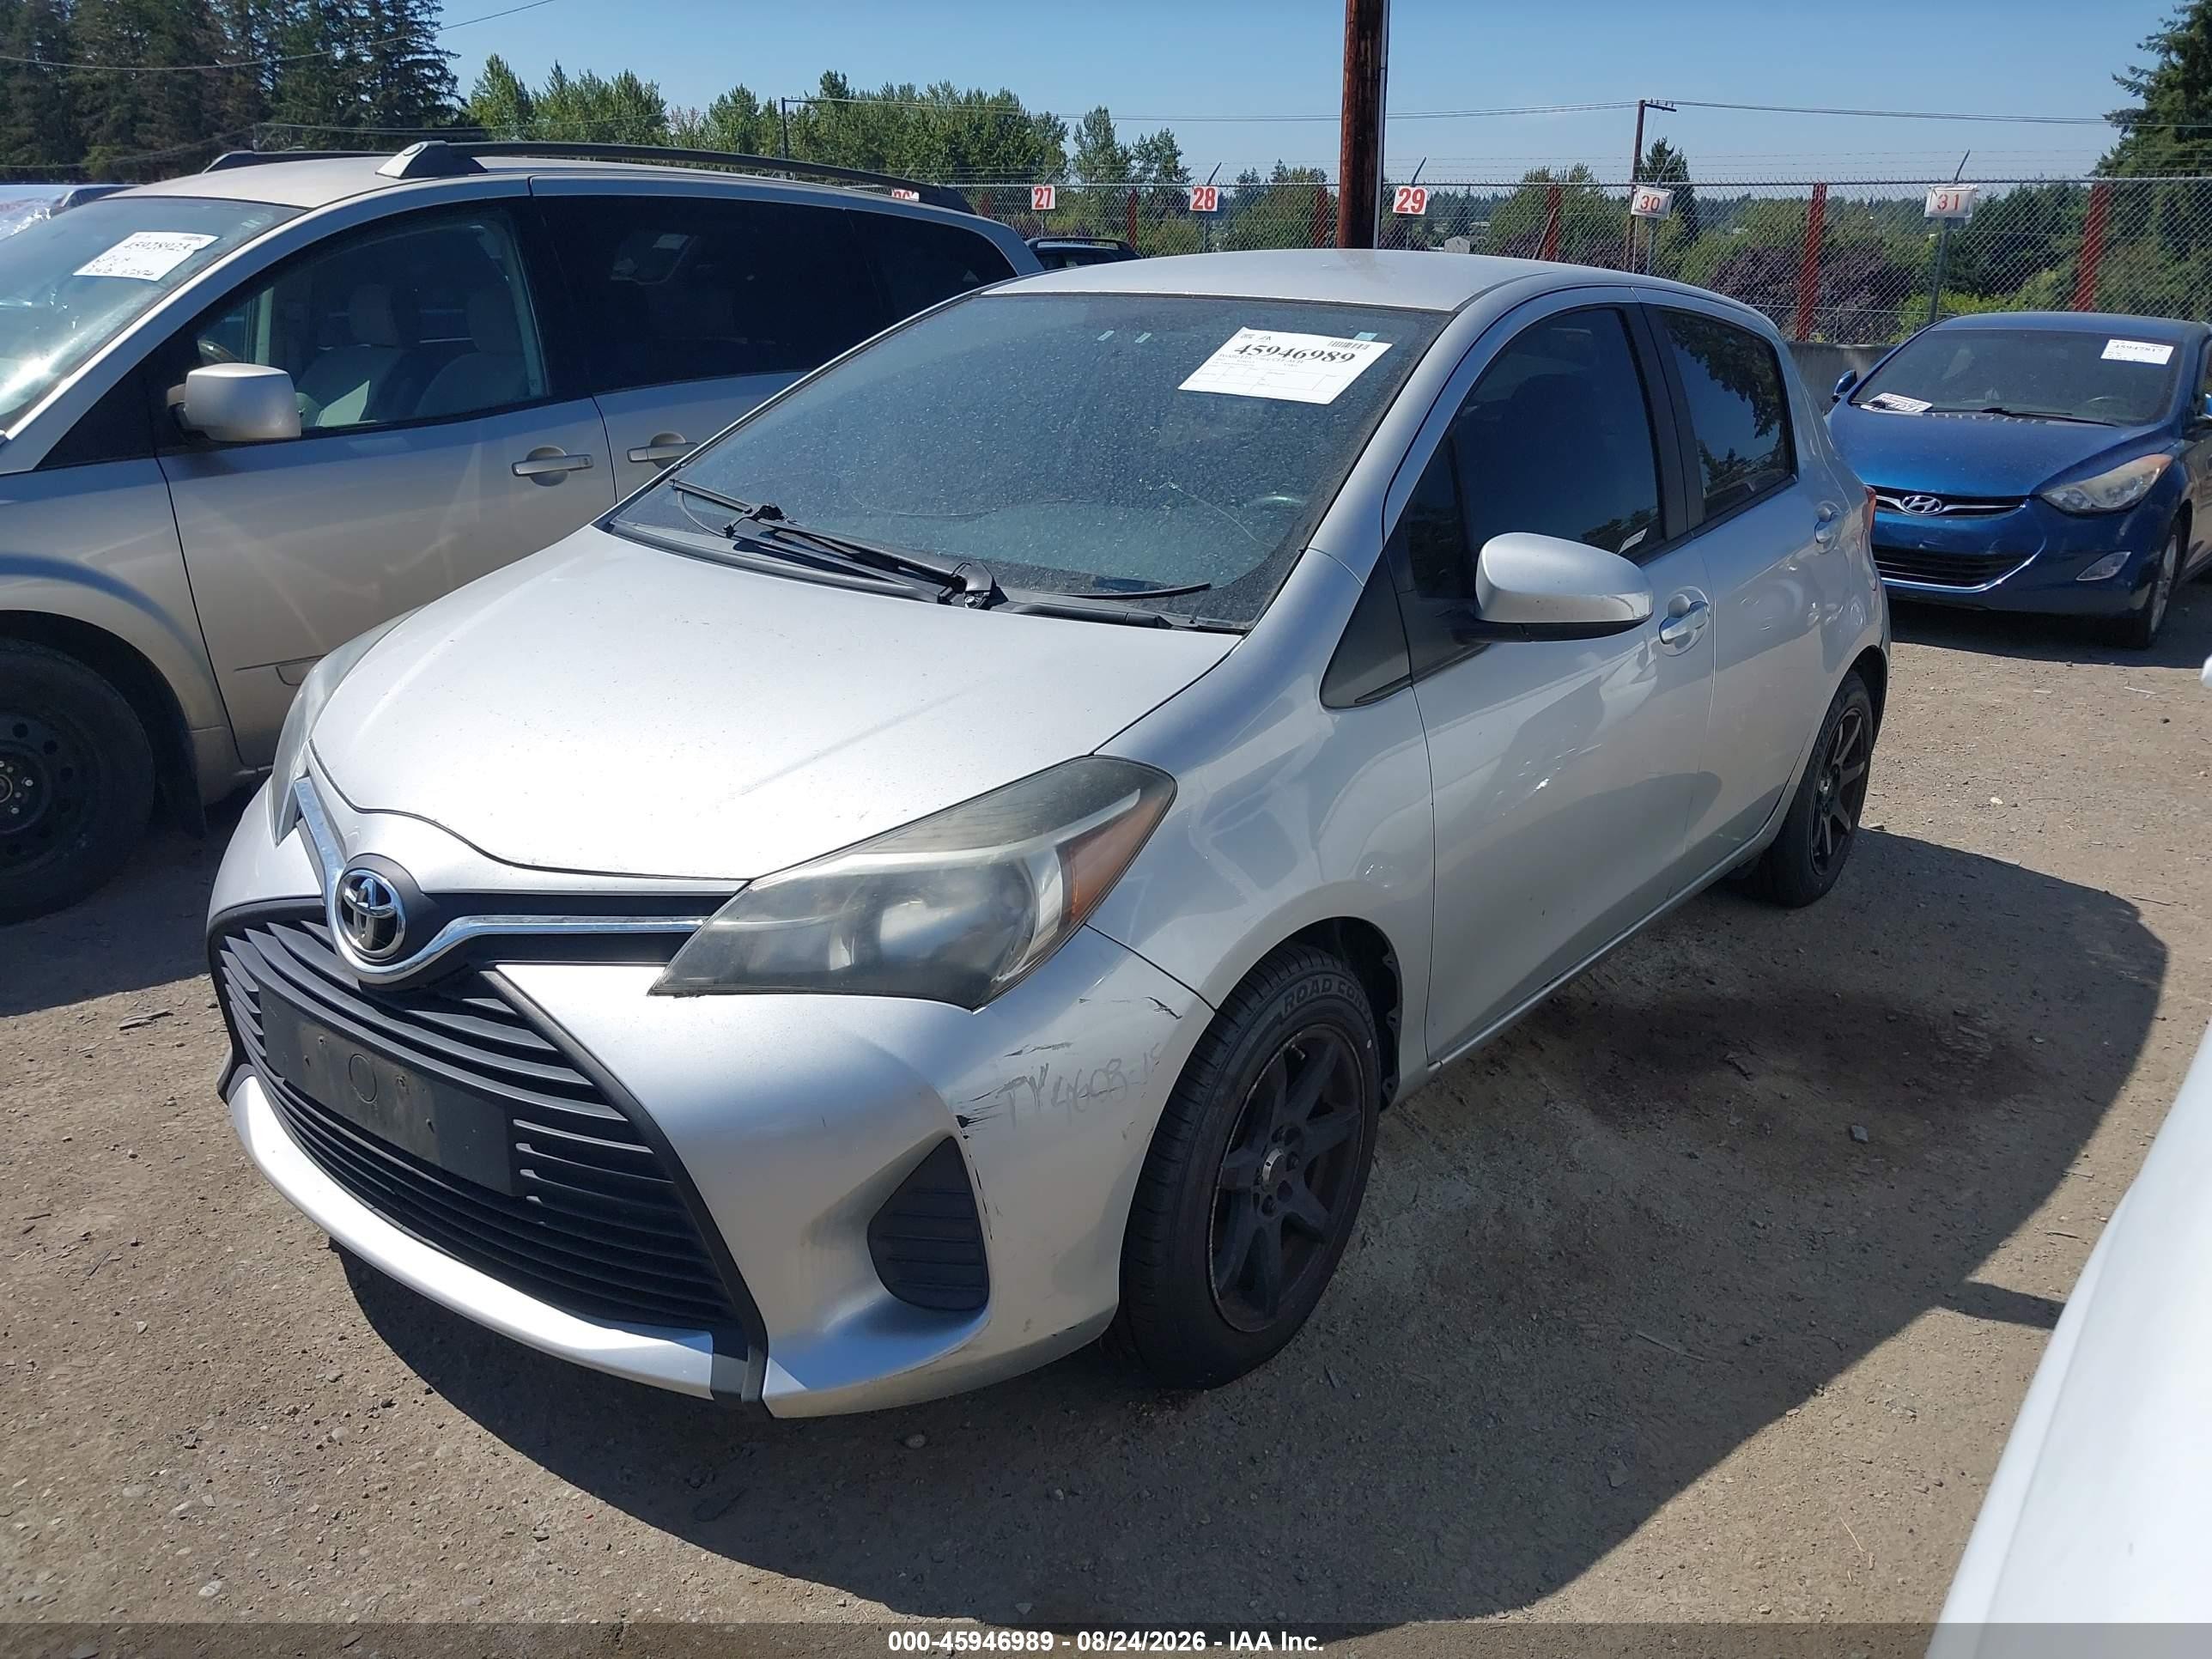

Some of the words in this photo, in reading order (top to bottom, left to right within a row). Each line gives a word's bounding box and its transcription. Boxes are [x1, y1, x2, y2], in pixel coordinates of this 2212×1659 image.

[1034, 187, 1052, 208] 27
[1193, 187, 1216, 210] 28
[1395, 188, 1425, 213] 29
[1640, 195, 1661, 211] 30
[1937, 193, 1960, 211] 31
[1234, 343, 1356, 363] 45946989
[1284, 978, 1333, 1015] ROAD
